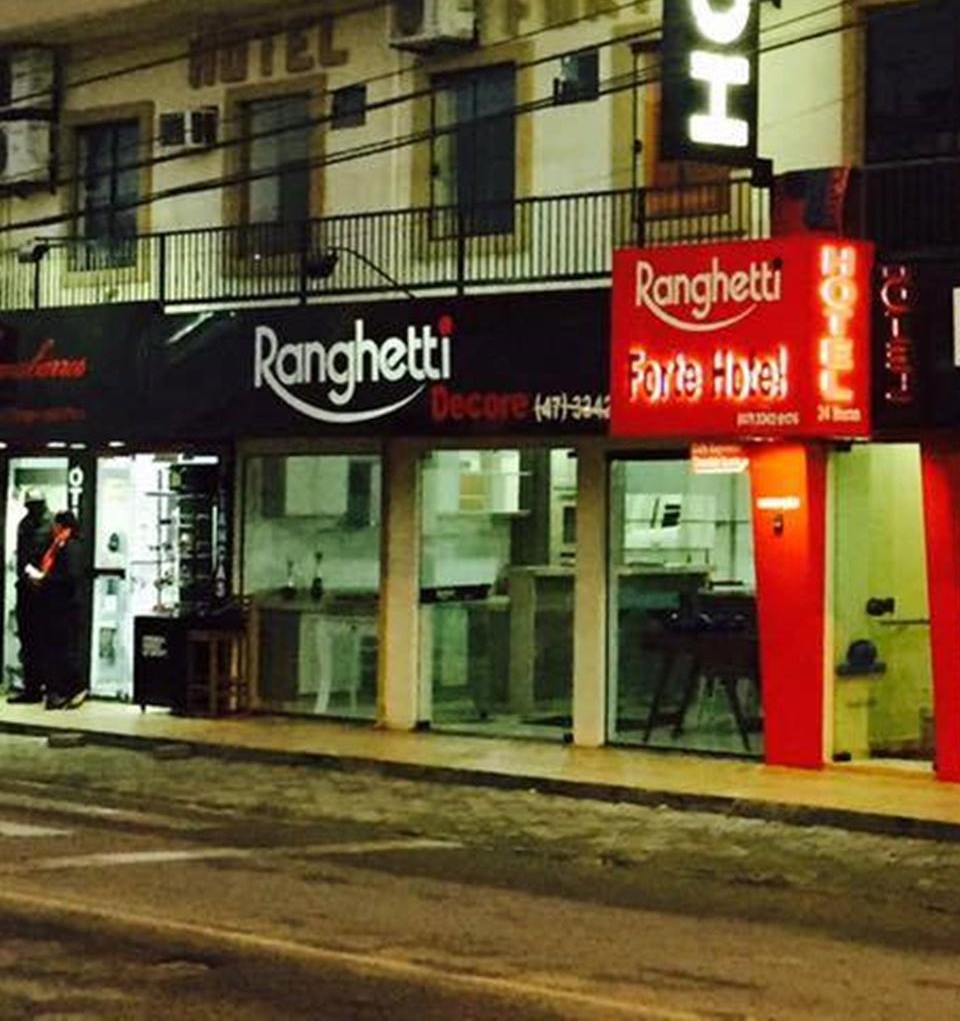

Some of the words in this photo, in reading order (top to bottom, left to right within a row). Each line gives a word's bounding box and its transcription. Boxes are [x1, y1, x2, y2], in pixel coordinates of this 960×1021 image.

[188, 16, 348, 89] HOTEL
[634, 257, 782, 331] Ranghetti
[819, 244, 857, 403] HOTEL
[254, 314, 455, 423] Ranghetti
[430, 384, 529, 422] Decore
[534, 392, 567, 422] (47)
[713, 344, 789, 401] Hotel
